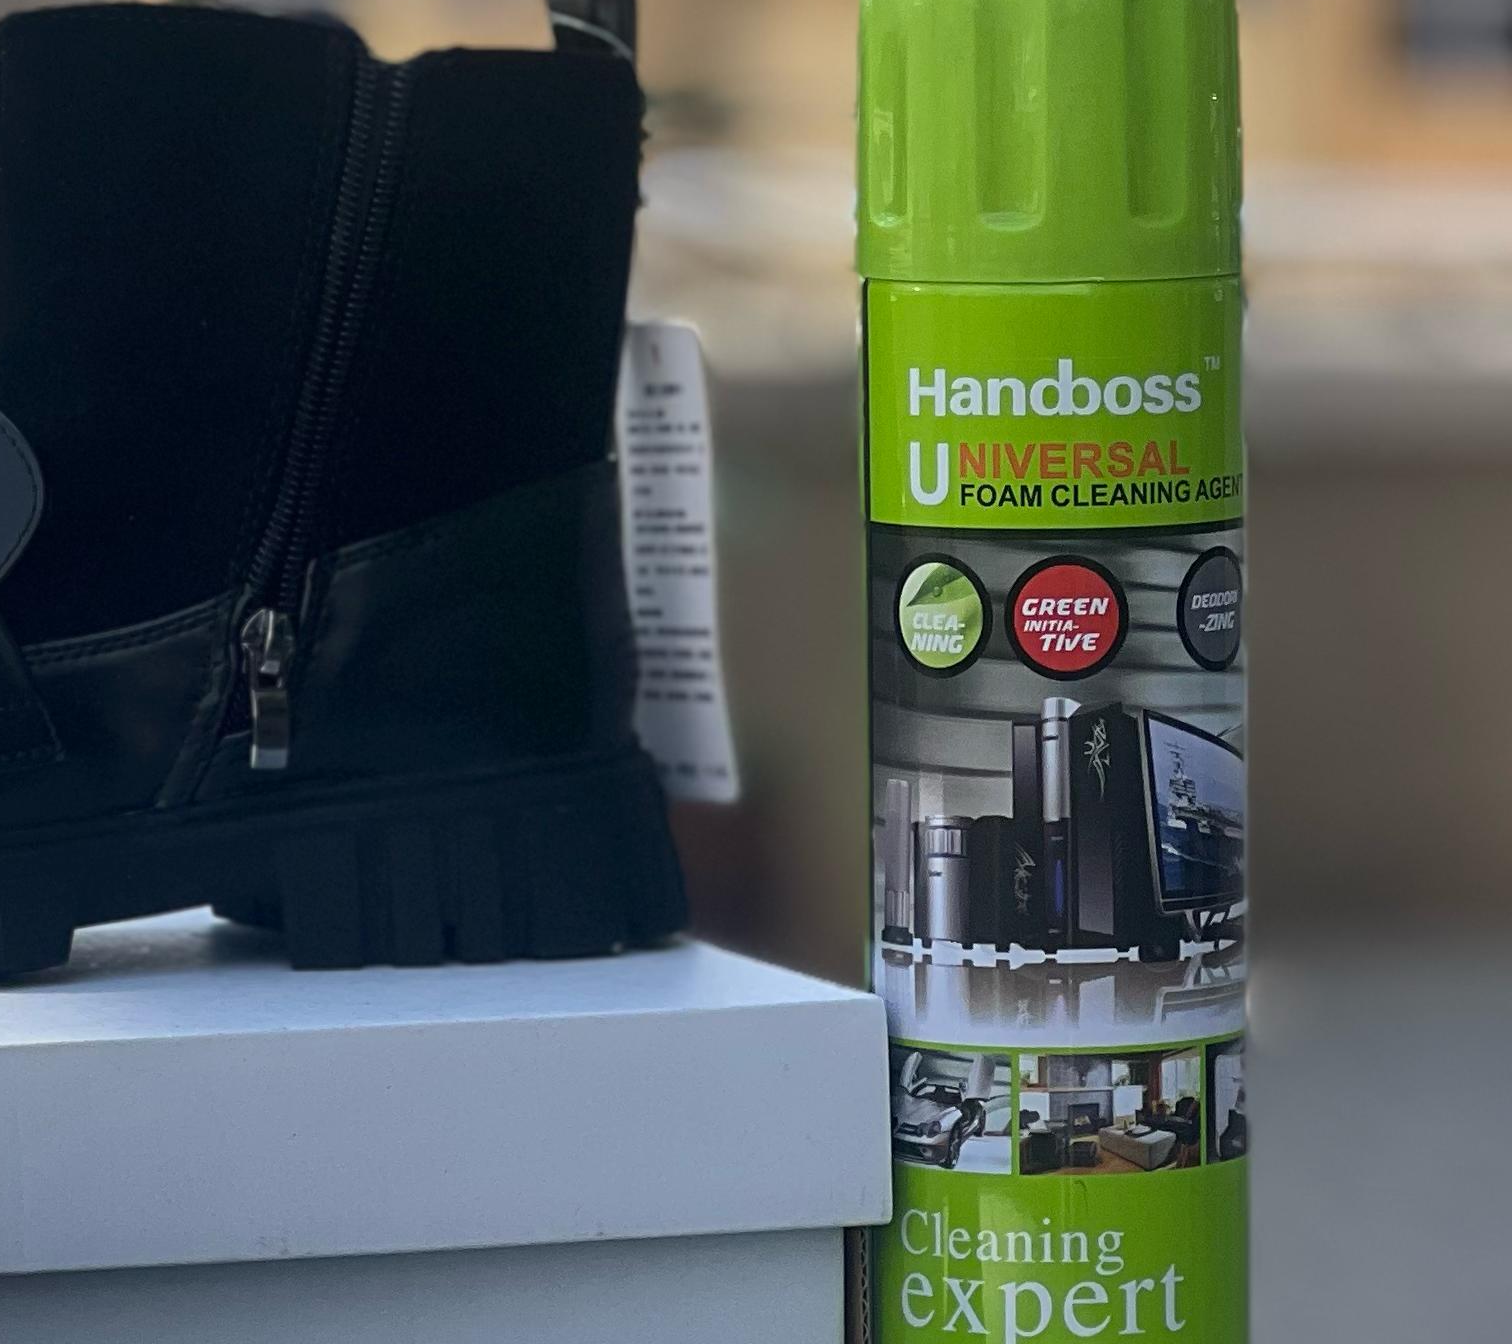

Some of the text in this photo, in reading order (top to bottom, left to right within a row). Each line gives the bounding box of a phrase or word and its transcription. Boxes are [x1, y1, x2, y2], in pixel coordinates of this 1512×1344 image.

[909, 358, 1201, 417] Handboss
[910, 441, 1191, 506] UNIVERSAL
[960, 483, 1043, 507] FOAM
[1050, 480, 1191, 507] CLEANING
[1021, 597, 1110, 617] GREEN
[912, 611, 966, 630] CLEA-
[1023, 620, 1080, 633] INITIA-
[911, 634, 964, 654] NING
[1038, 633, 1100, 653] TIVE
[900, 1208, 1125, 1276] Cleaning
